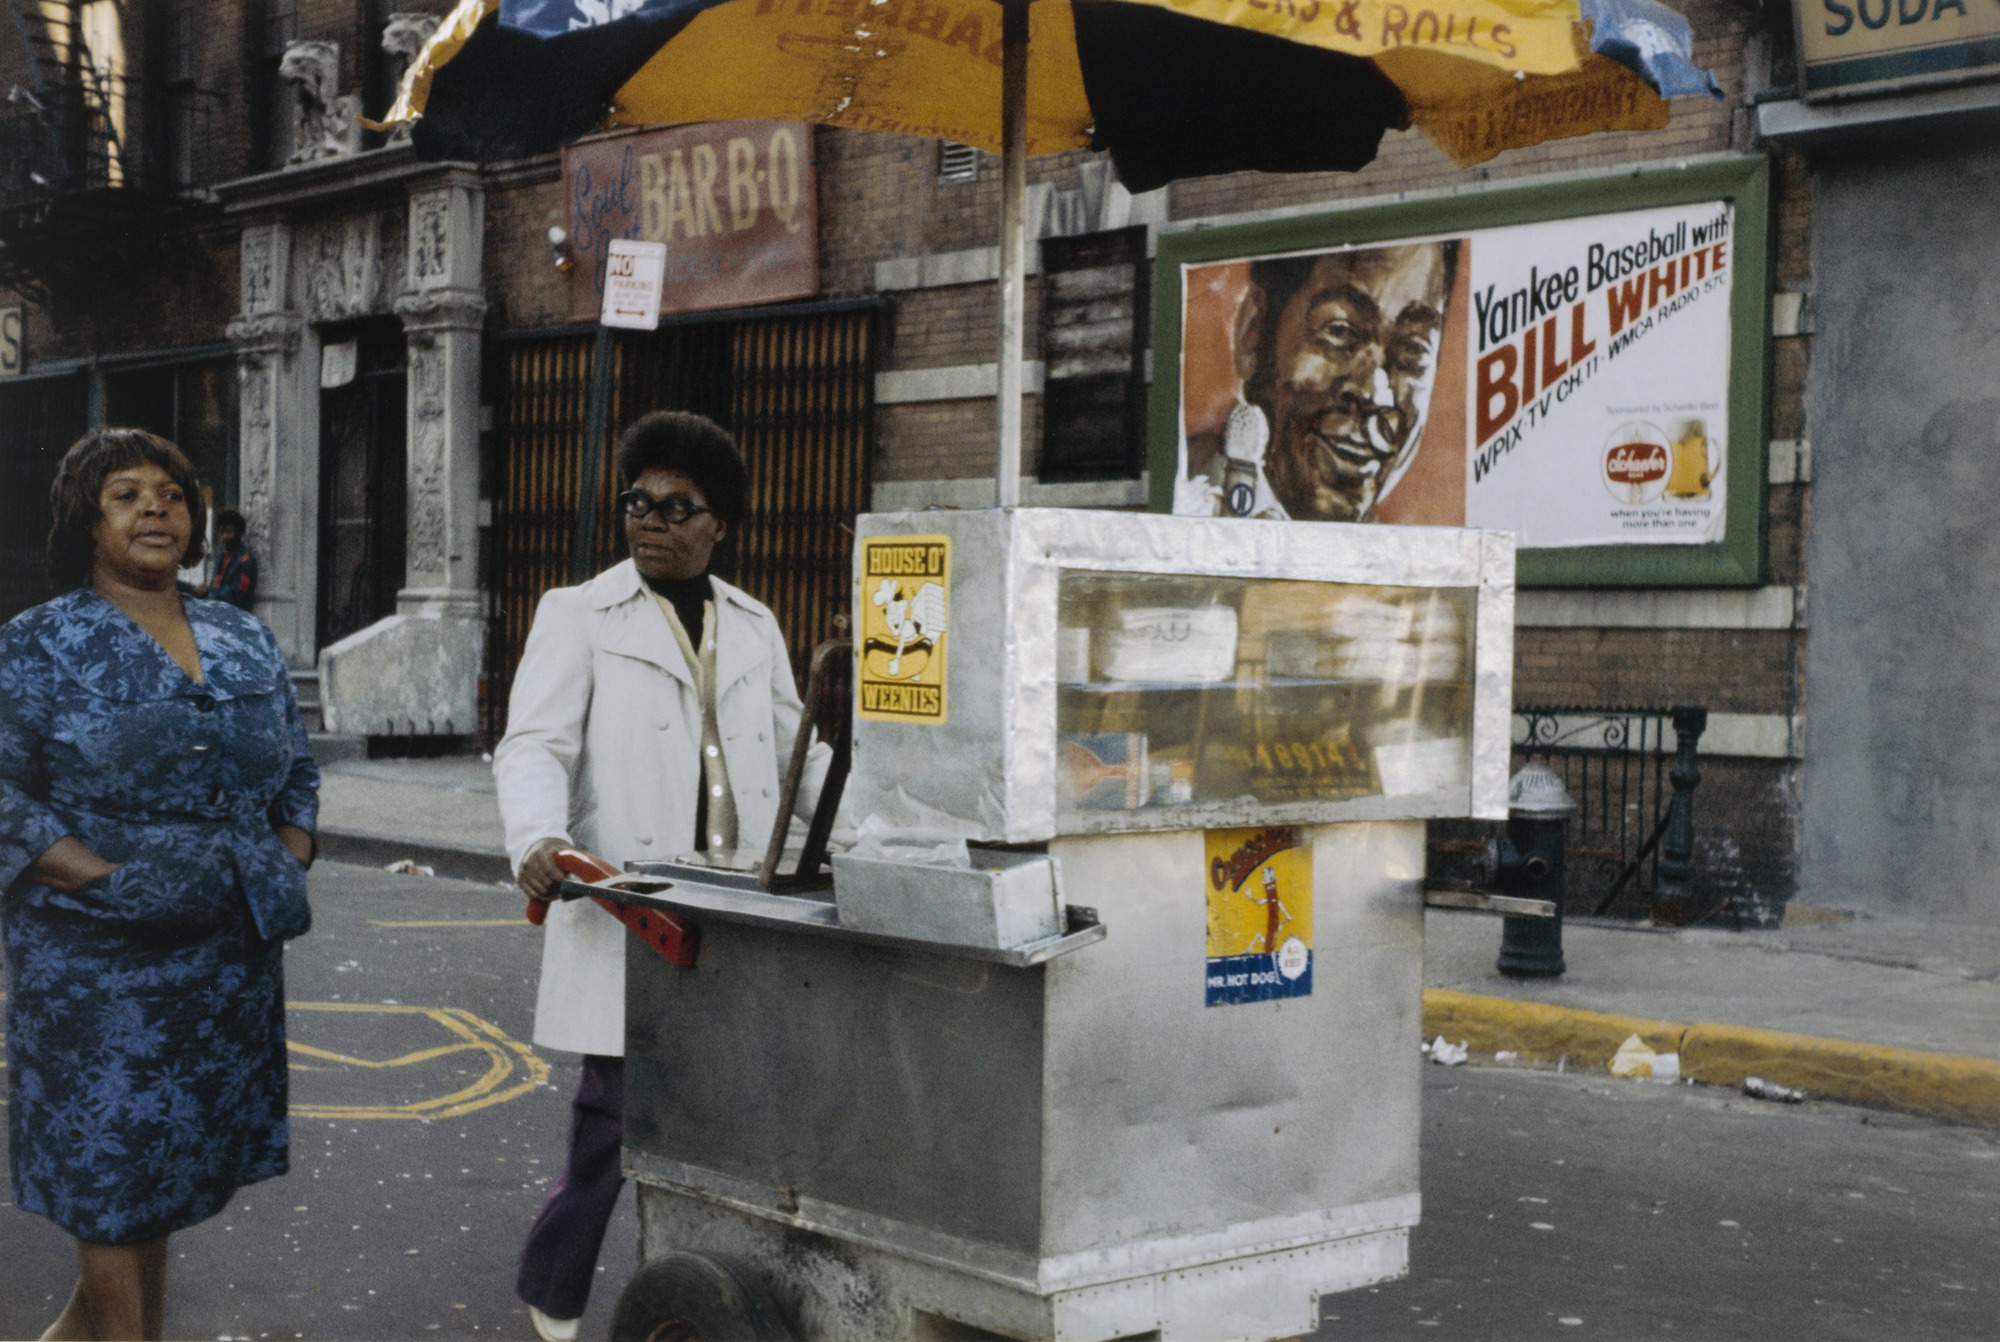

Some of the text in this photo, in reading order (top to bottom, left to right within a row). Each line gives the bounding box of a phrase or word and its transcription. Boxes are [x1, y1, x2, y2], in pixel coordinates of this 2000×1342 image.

[609, 254, 633, 276] NO
[1474, 214, 1729, 353] Yankee Baseball with
[1608, 317, 1653, 361] WMCA
[1658, 286, 1700, 325] RADIO
[1476, 241, 1727, 450] BILL WHITE
[1611, 507, 1711, 518] when you're having
[1622, 519, 1697, 528] more than one
[870, 547, 925, 574] HOUSE
[865, 684, 939, 713] WEENIES
[1227, 974, 1248, 986] HOT
[1251, 971, 1275, 983] DOG
